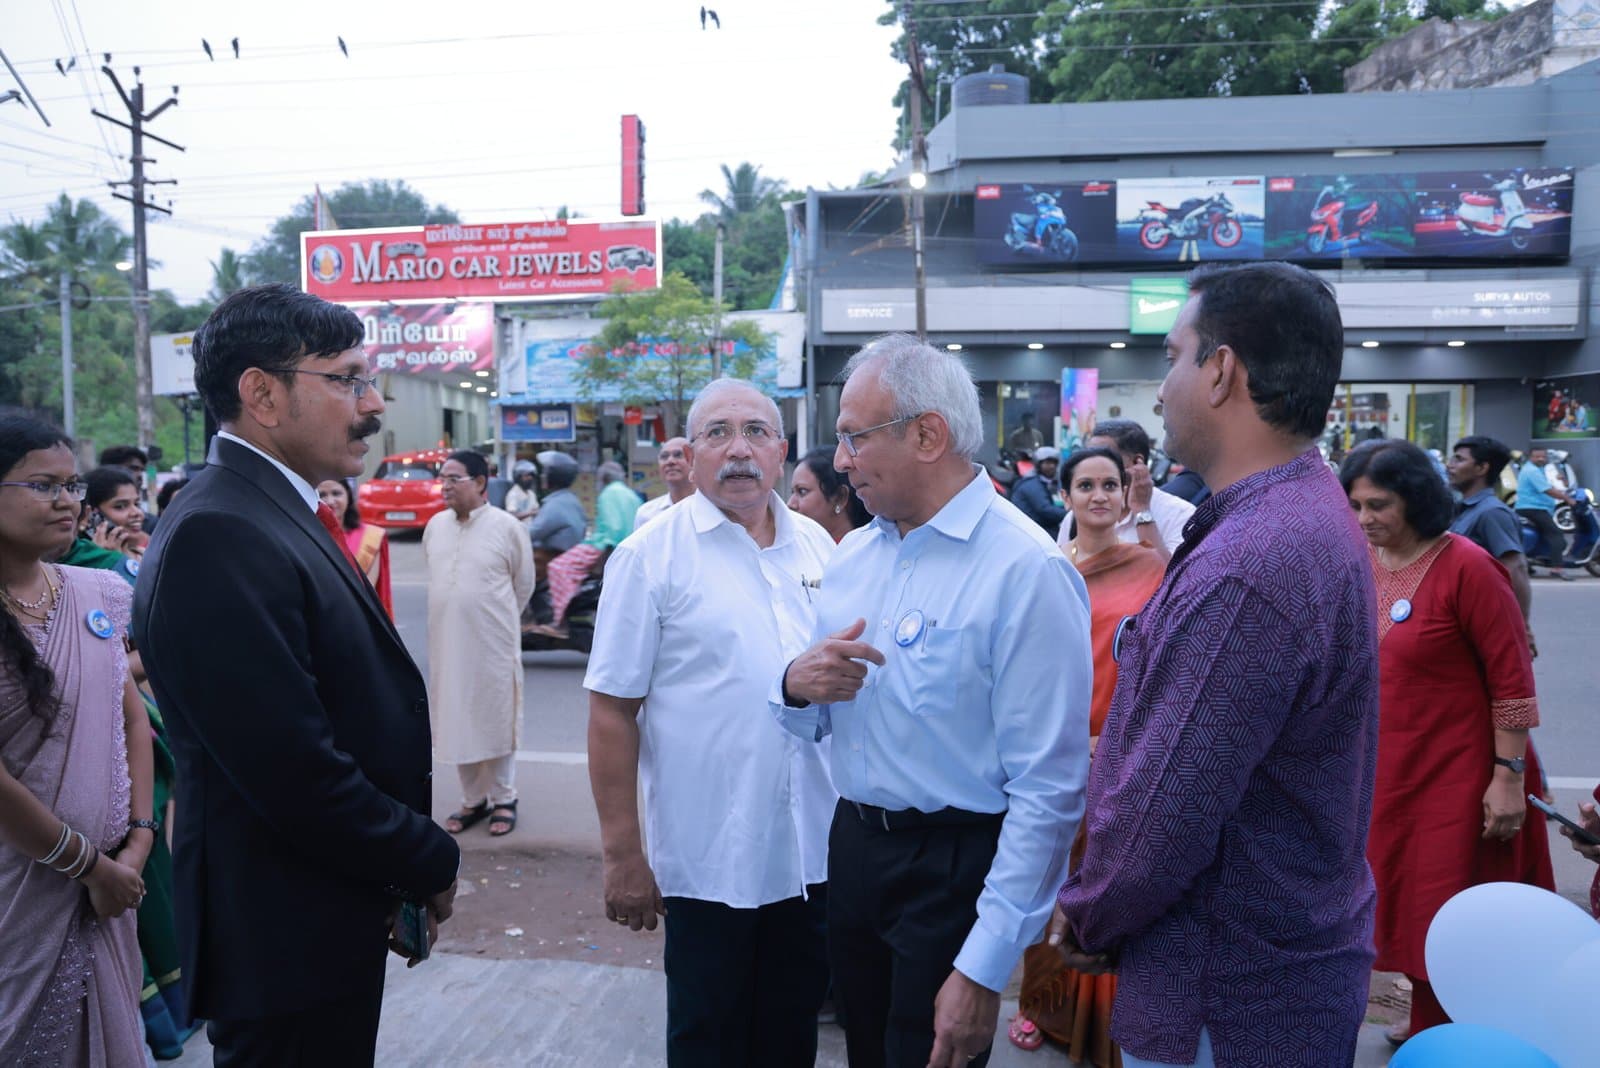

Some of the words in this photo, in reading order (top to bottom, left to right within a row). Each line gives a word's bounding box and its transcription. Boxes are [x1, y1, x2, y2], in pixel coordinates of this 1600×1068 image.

[350, 241, 444, 283] MARIO
[449, 255, 502, 278] CAR
[507, 250, 603, 277] JEWELS
[530, 279, 546, 289] Car
[1511, 291, 1552, 301] AUTOS
[847, 307, 893, 318] SERVICE
